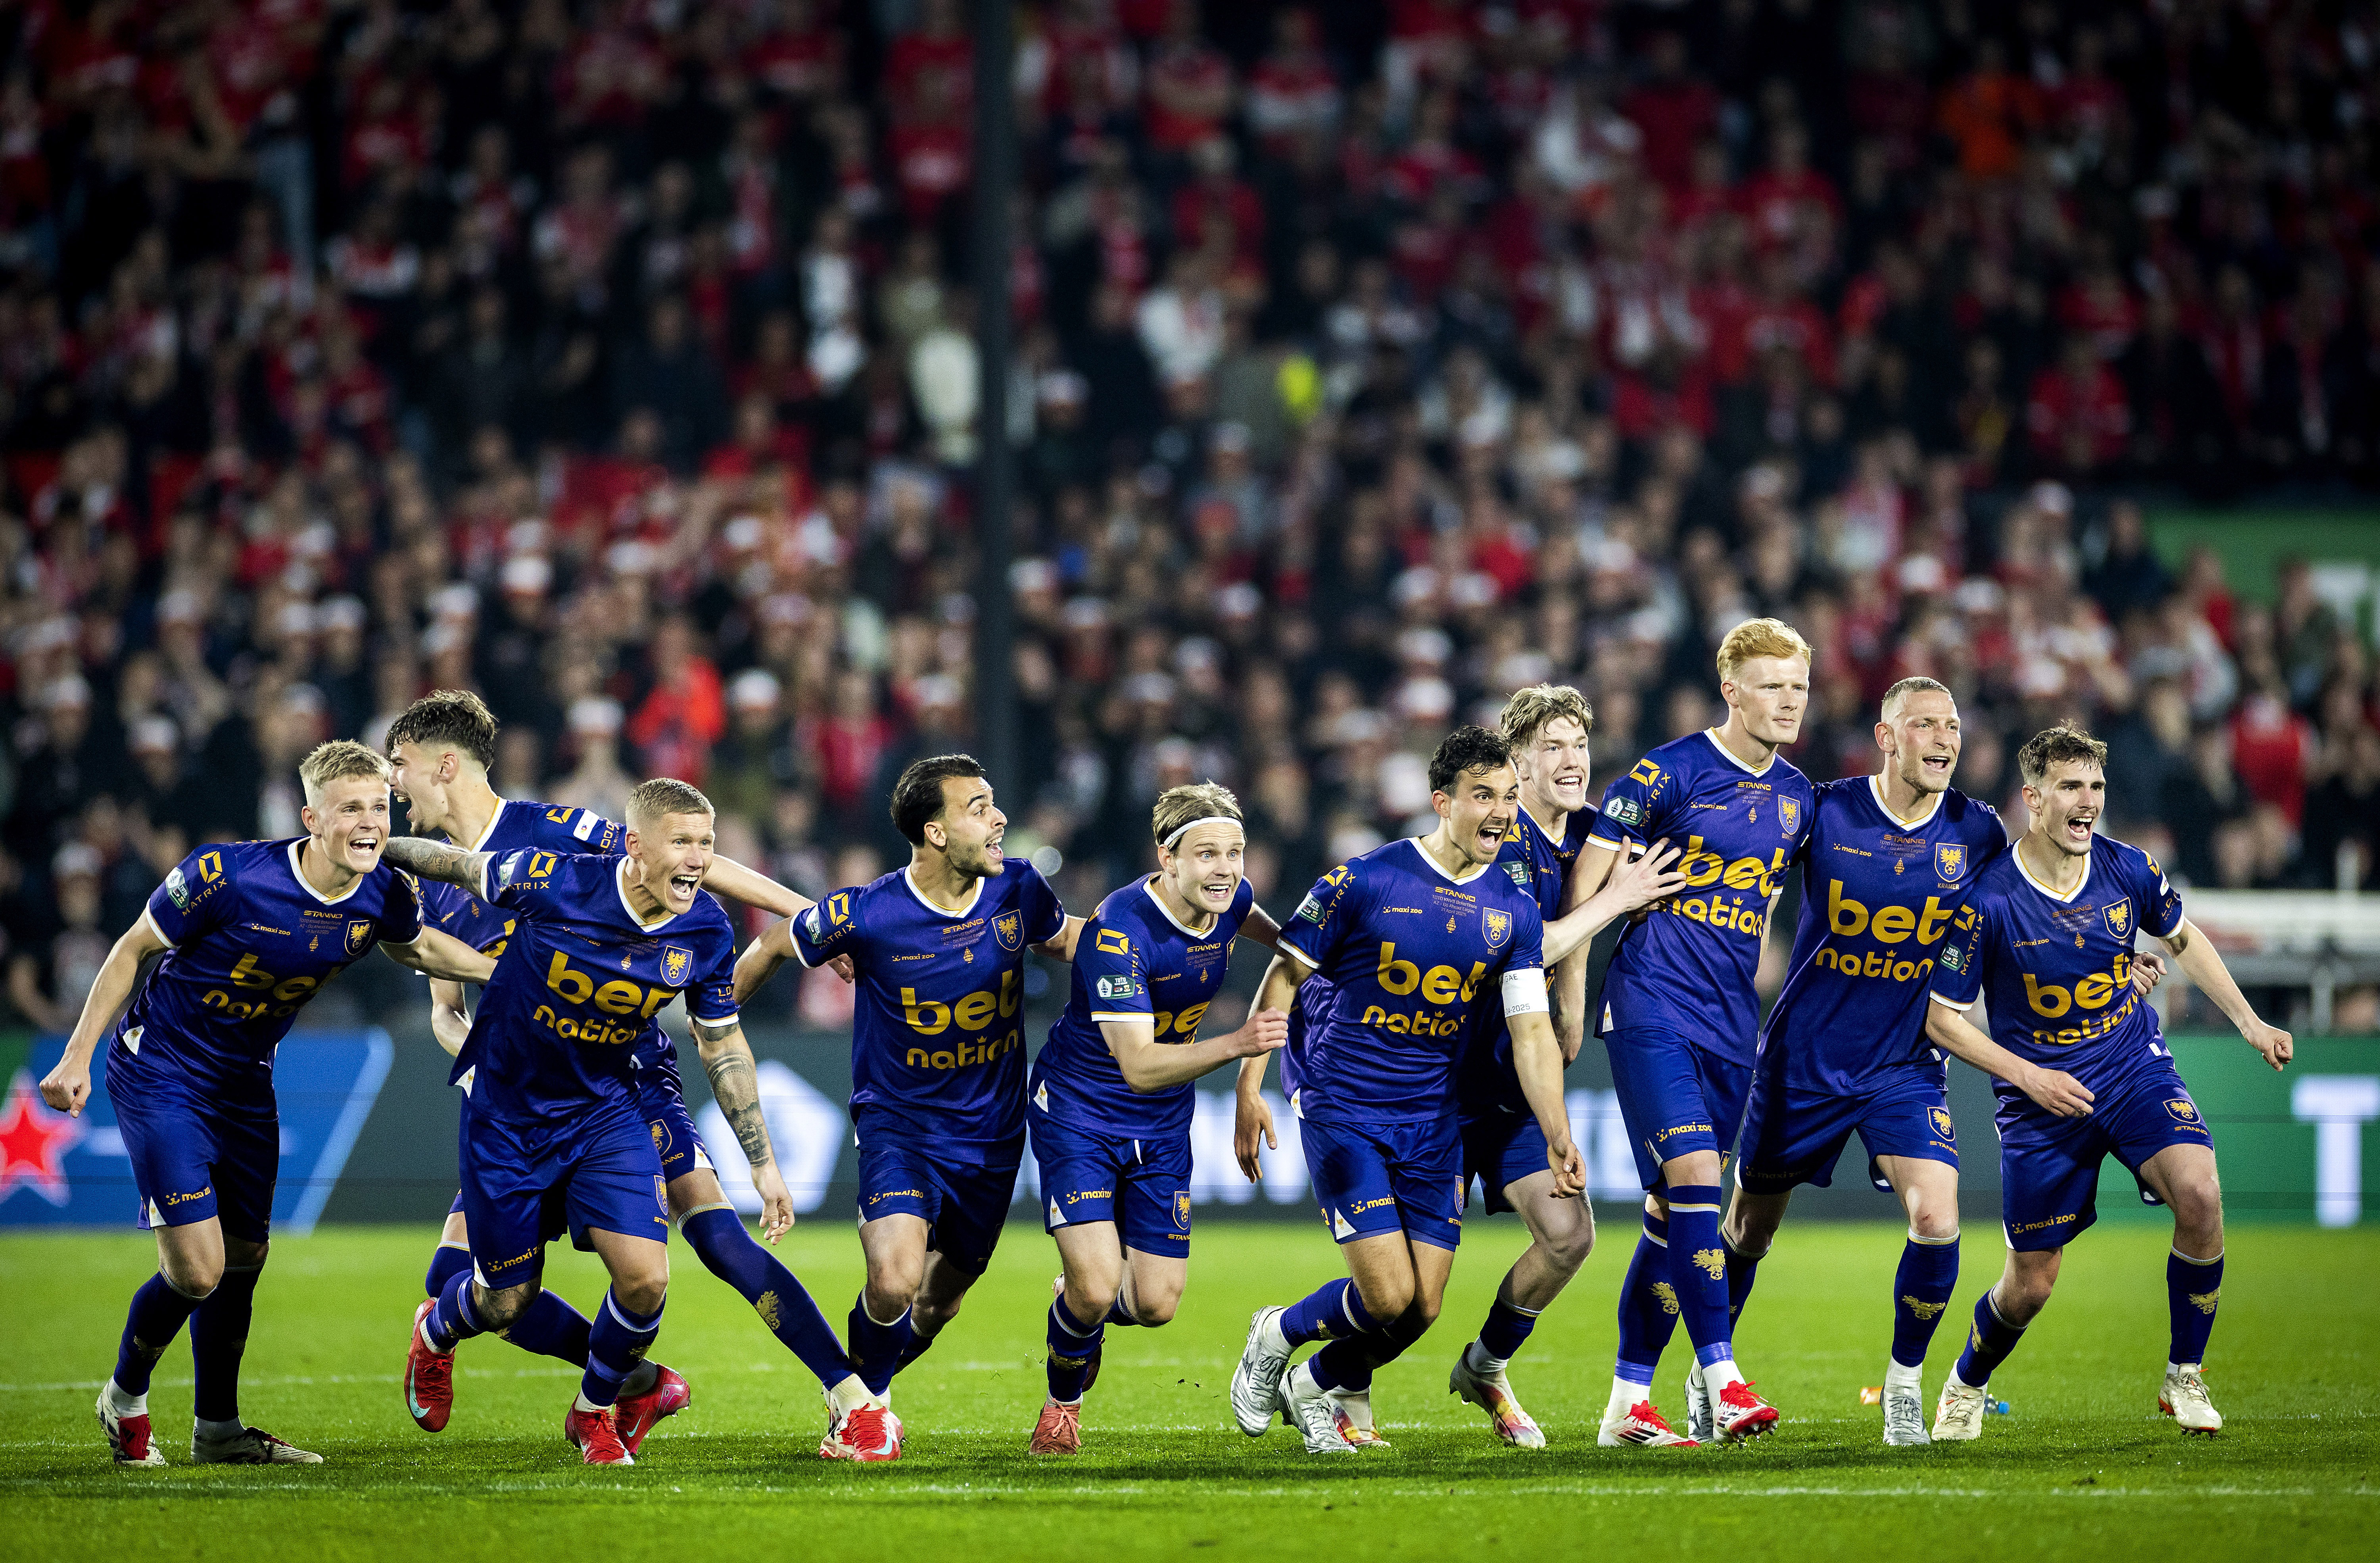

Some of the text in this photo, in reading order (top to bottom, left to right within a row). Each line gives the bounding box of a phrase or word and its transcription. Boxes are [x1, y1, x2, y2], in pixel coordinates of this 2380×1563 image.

[1737, 782, 1772, 791] STANNO
[1884, 834, 1926, 845] STANNO
[1841, 846, 1859, 854] maxi
[1677, 835, 1785, 898] bet
[499, 881, 550, 893] MATRIX
[1435, 886, 1476, 902] STANNO
[182, 877, 227, 917] MATRIX
[1309, 899, 1320, 909] TOTO
[1318, 873, 1357, 930] MATRIX
[303, 910, 343, 919] STANNO
[1659, 895, 1762, 937] nation
[1828, 878, 1954, 945] bet
[2052, 904, 2092, 918] STANNO
[260, 925, 278, 933] maxi
[942, 918, 984, 934] STANNO
[819, 921, 856, 950] MATRIX
[1187, 943, 1221, 953] STANNO
[1948, 947, 1959, 956] TOTO
[1960, 913, 1984, 975] MATRIX
[1132, 944, 1144, 995] MTRIX
[1377, 941, 1487, 1004] bet
[1816, 947, 1934, 982] nation
[1505, 974, 1518, 982] GAE
[2023, 952, 2132, 1018] bet
[900, 969, 1020, 1035] bet
[533, 1005, 637, 1045] natio
[1360, 1005, 1466, 1037] natio
[2033, 992, 2138, 1045] nation
[907, 1029, 1019, 1070] nation
[1668, 1121, 1697, 1136] maxi
[2175, 1125, 2208, 1136] STANNO
[1929, 1141, 1958, 1156] STANNO
[661, 1152, 684, 1166] ANNO
[883, 1189, 924, 1198] maxi zoo
[1081, 1187, 1104, 1199] maxi
[1367, 1193, 1391, 1208] maxi
[2025, 1214, 2076, 1231] maxi zoo
[503, 1248, 532, 1267] maxi
